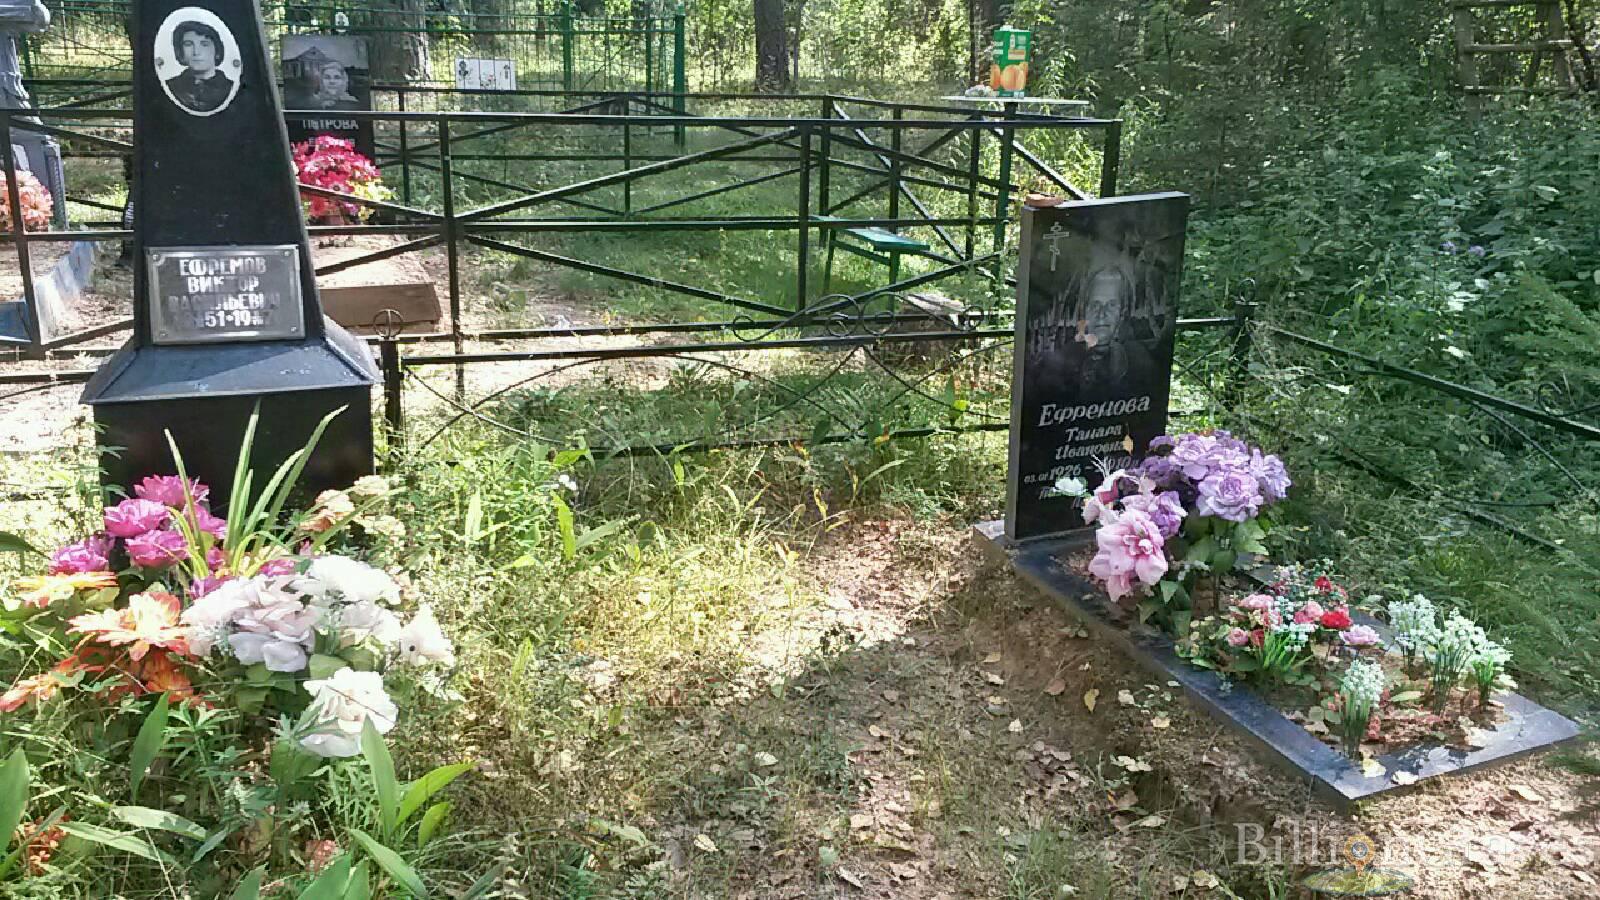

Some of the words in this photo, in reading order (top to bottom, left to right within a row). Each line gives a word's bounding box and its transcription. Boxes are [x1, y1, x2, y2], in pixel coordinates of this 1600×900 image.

[302, 119, 360, 130] ПЕТРОВА
[179, 256, 266, 276] ЕФРЕМОВ
[187, 275, 259, 293] ВИКТОР
[168, 293, 280, 313] ВАСЛЬЕВИЧ
[1038, 396, 1151, 427] Ефремова
[1065, 425, 1122, 442] Тамара
[1055, 440, 1125, 460] Ивановн
[1094, 455, 1131, 473] 010
